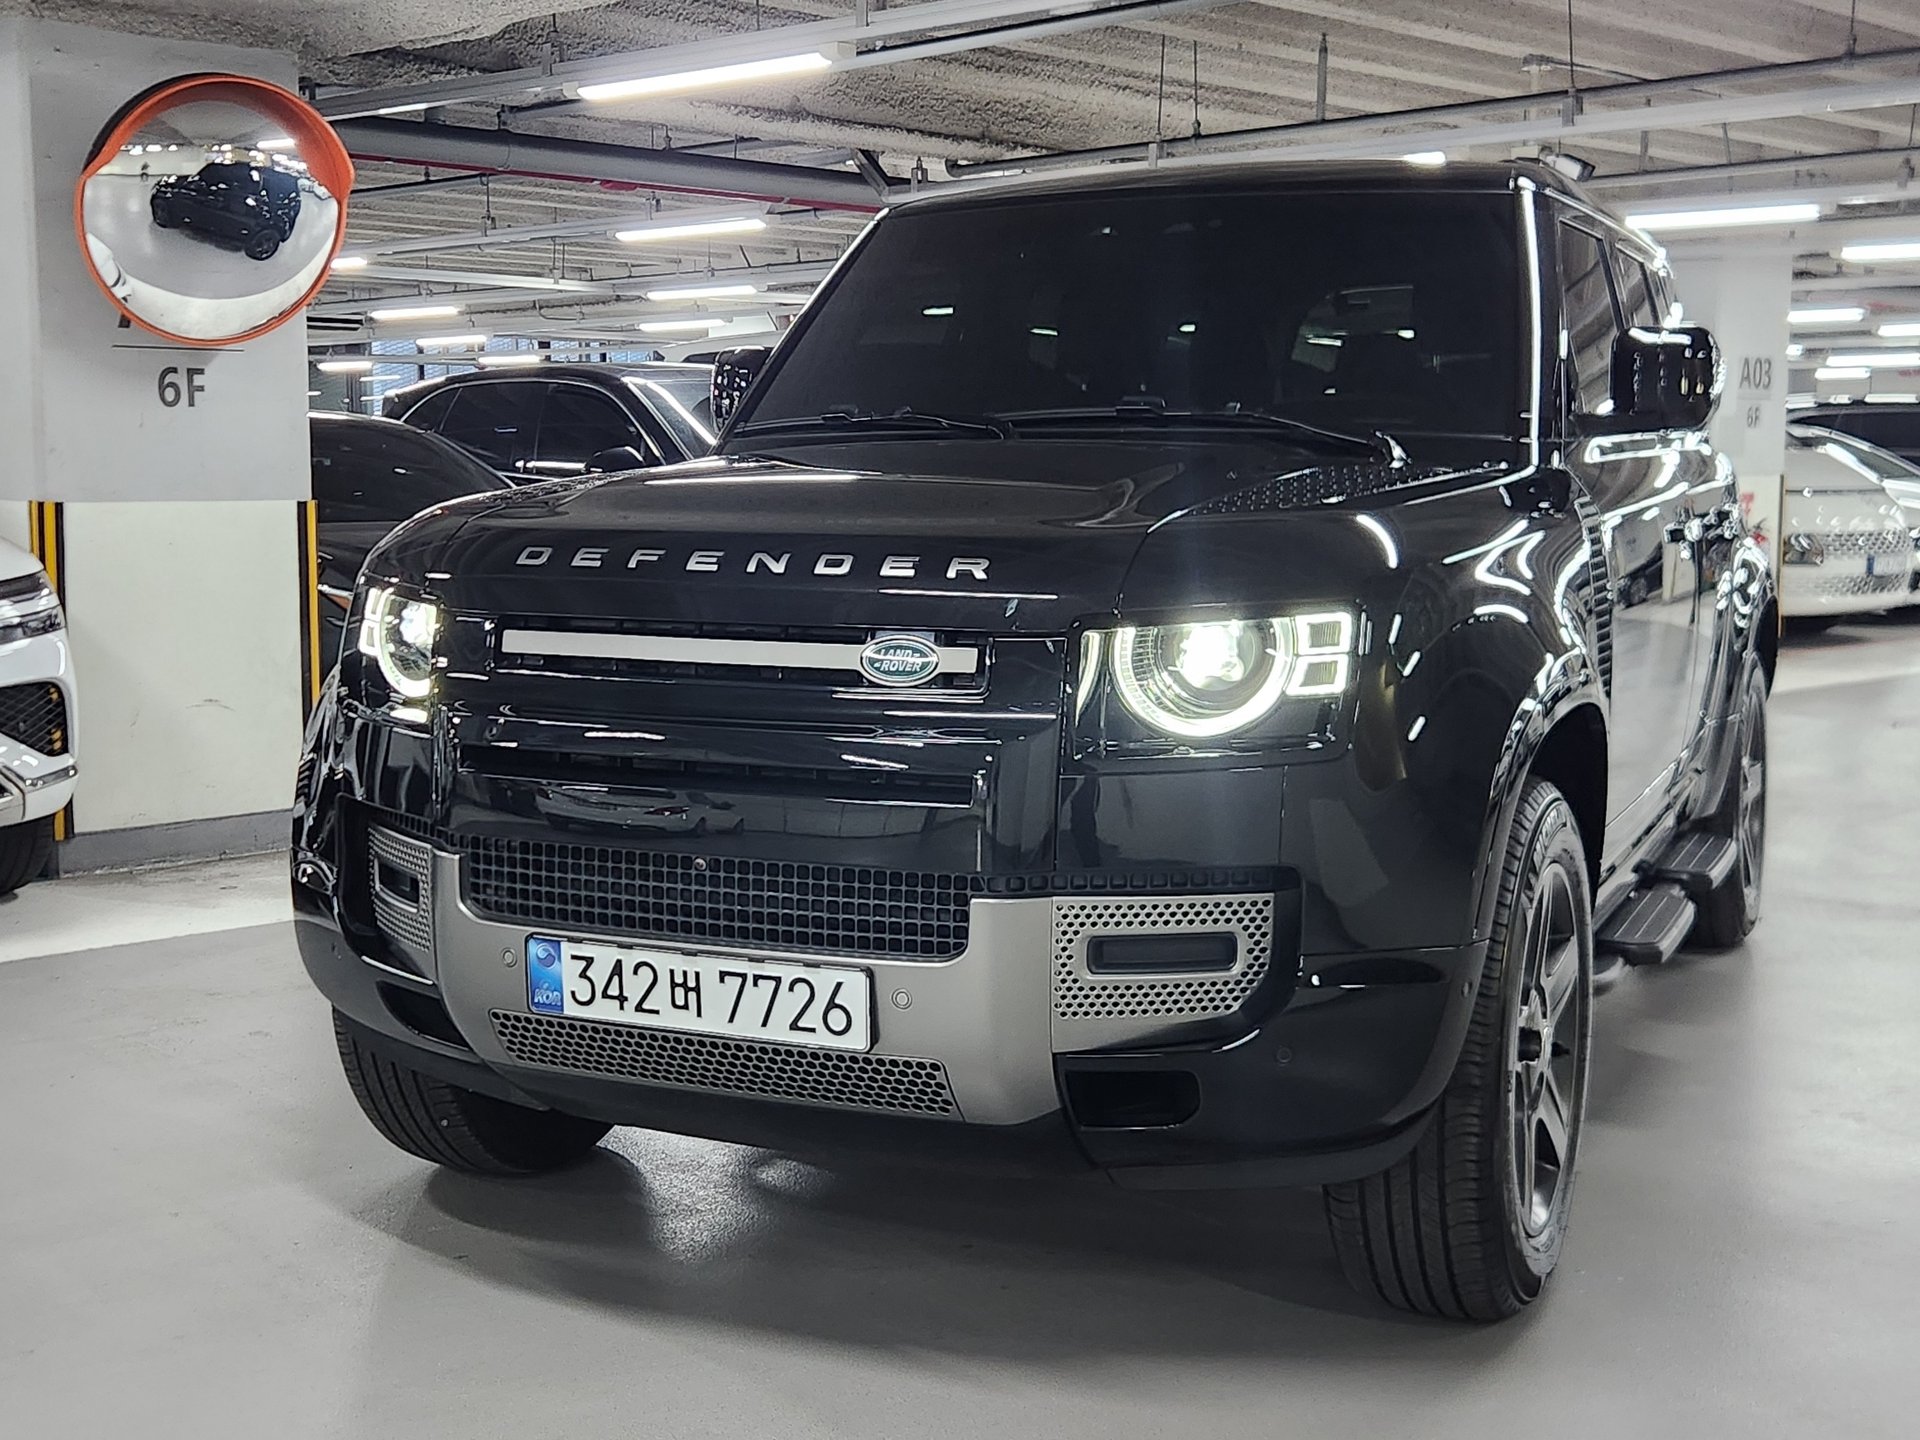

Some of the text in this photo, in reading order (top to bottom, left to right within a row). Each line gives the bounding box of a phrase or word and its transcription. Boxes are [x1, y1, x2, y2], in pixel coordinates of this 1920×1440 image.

[158, 366, 206, 408] 6F
[1739, 357, 1772, 390] A03
[515, 546, 991, 580] DEFENDER
[879, 660, 922, 672] ROVER
[880, 648, 913, 659] LAND
[570, 953, 853, 1037] 342버 7726
